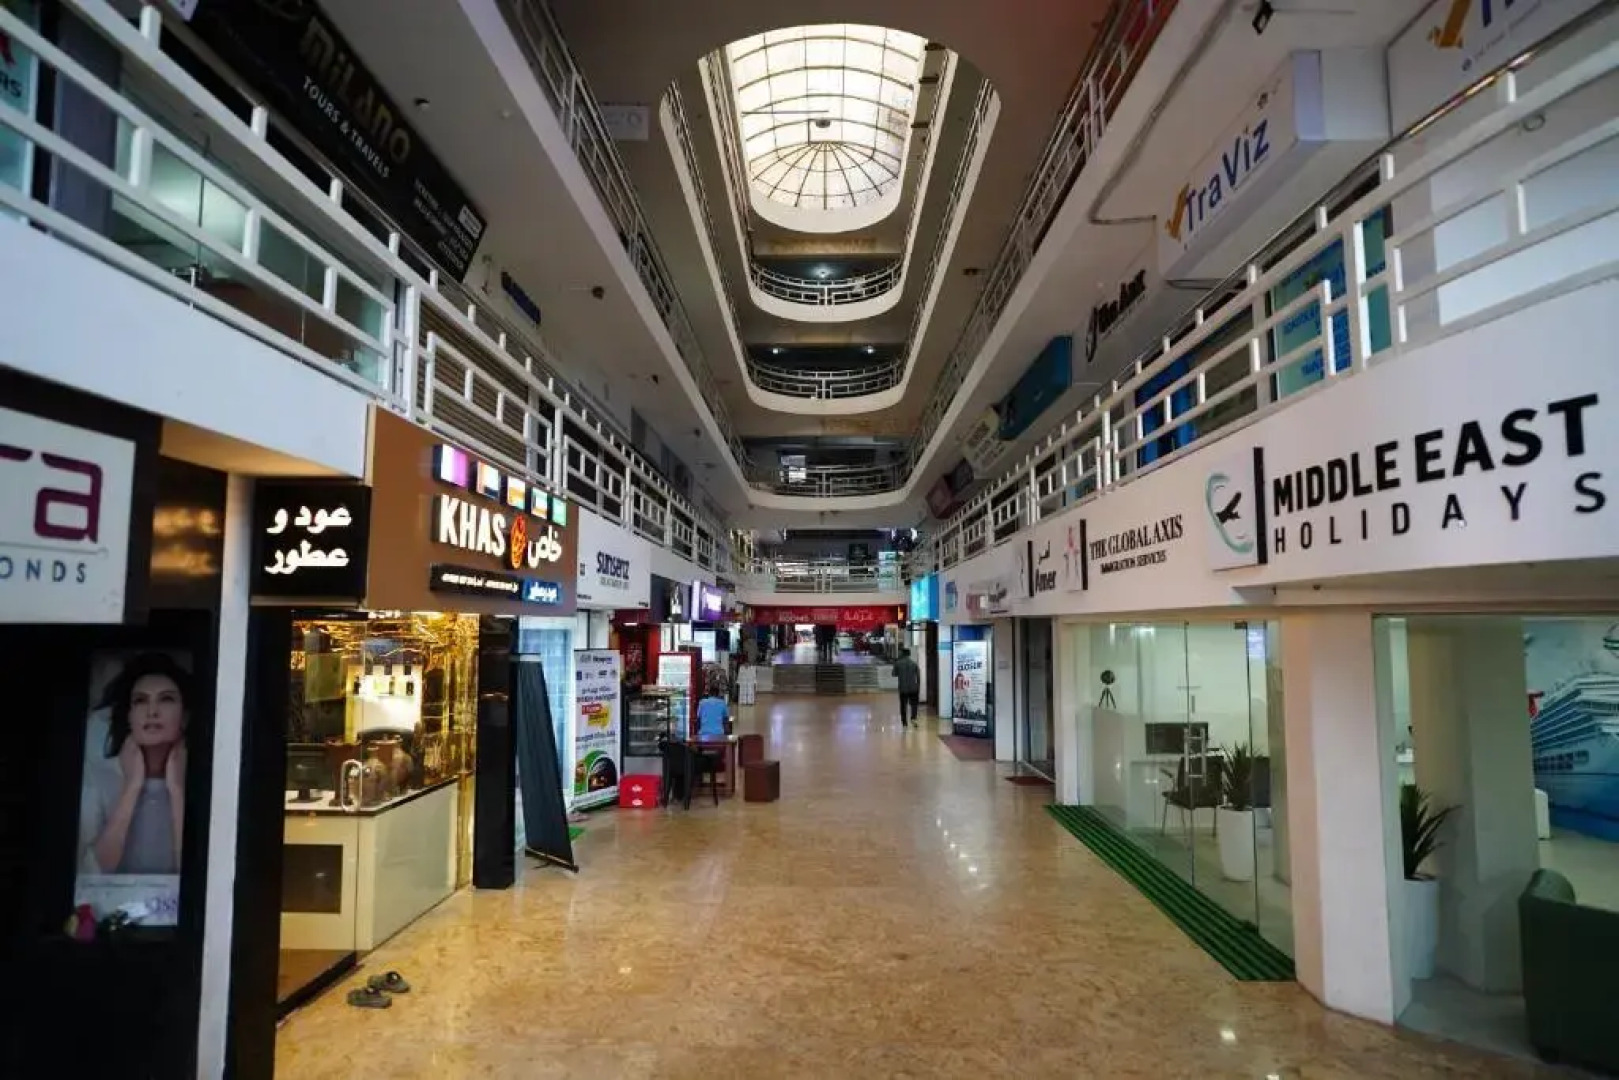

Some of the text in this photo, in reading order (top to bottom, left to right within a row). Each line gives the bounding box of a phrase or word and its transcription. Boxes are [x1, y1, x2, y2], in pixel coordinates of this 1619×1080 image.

[1273, 393, 1599, 516] MIDDLE EAST
[294, 505, 352, 534] عود
[440, 494, 507, 557] KHAS
[1089, 514, 1184, 560] THE GLOBAL AXIS
[1274, 472, 1607, 554] HOLIDAYS
[264, 539, 350, 574] عطور
